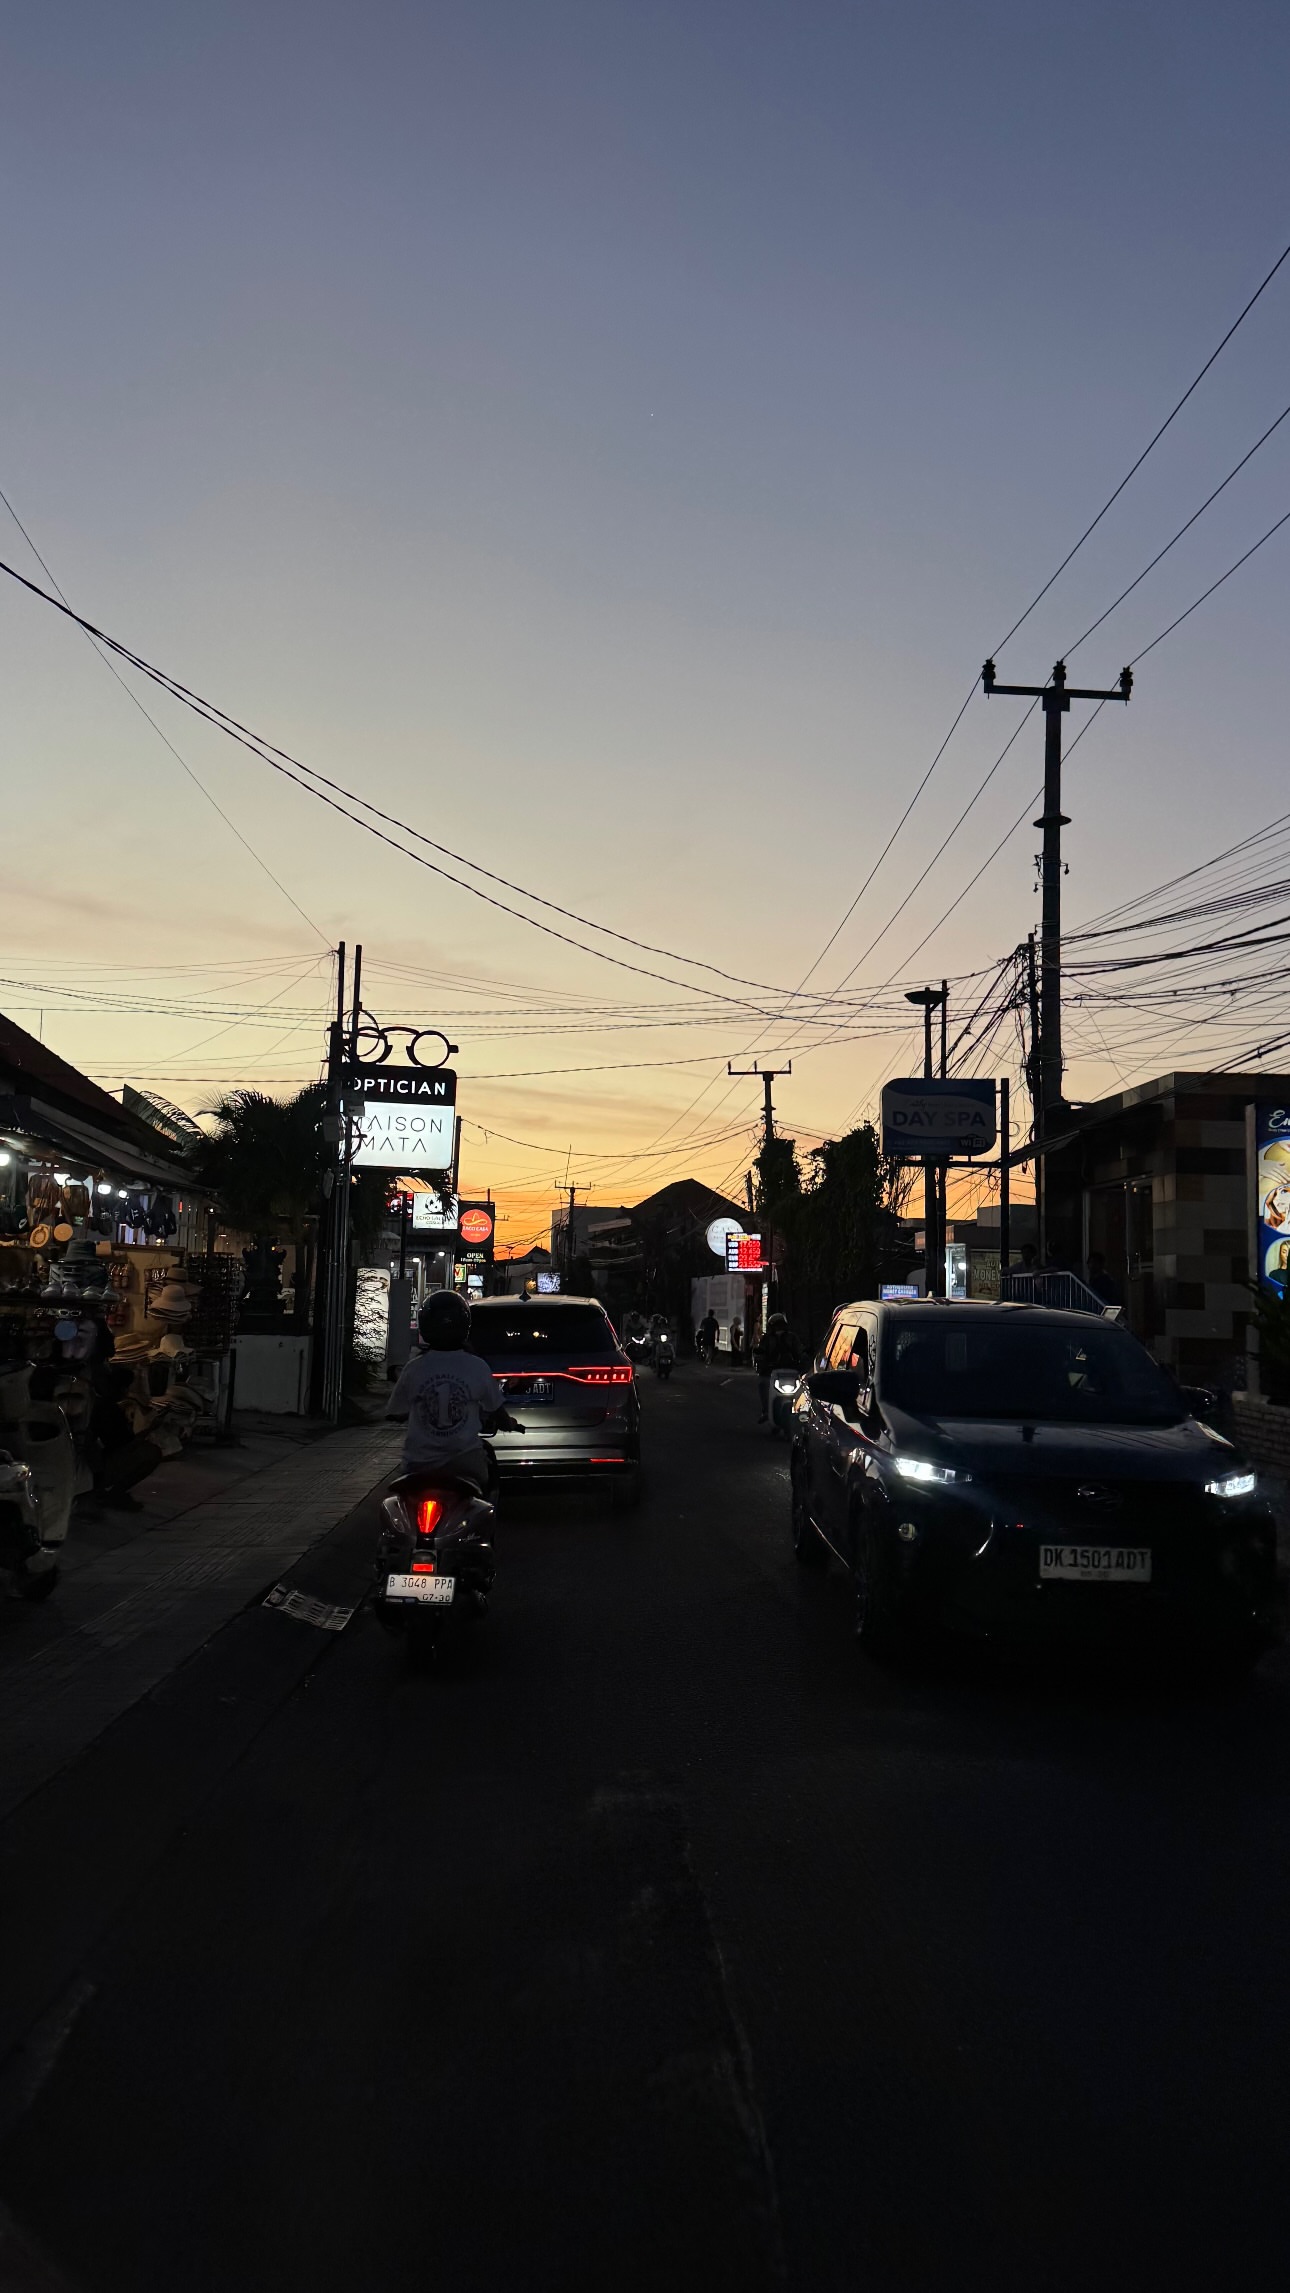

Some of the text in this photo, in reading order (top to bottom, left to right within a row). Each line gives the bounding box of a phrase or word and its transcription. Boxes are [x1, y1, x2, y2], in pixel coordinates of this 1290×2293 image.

[892, 1111, 986, 1127] DAY SPA
[360, 1136, 427, 1153] MATA
[533, 1383, 551, 1393] ADT
[1043, 1548, 1148, 1570] DK 1501 ADT
[389, 1576, 396, 1587] B
[401, 1577, 427, 1588] 3048
